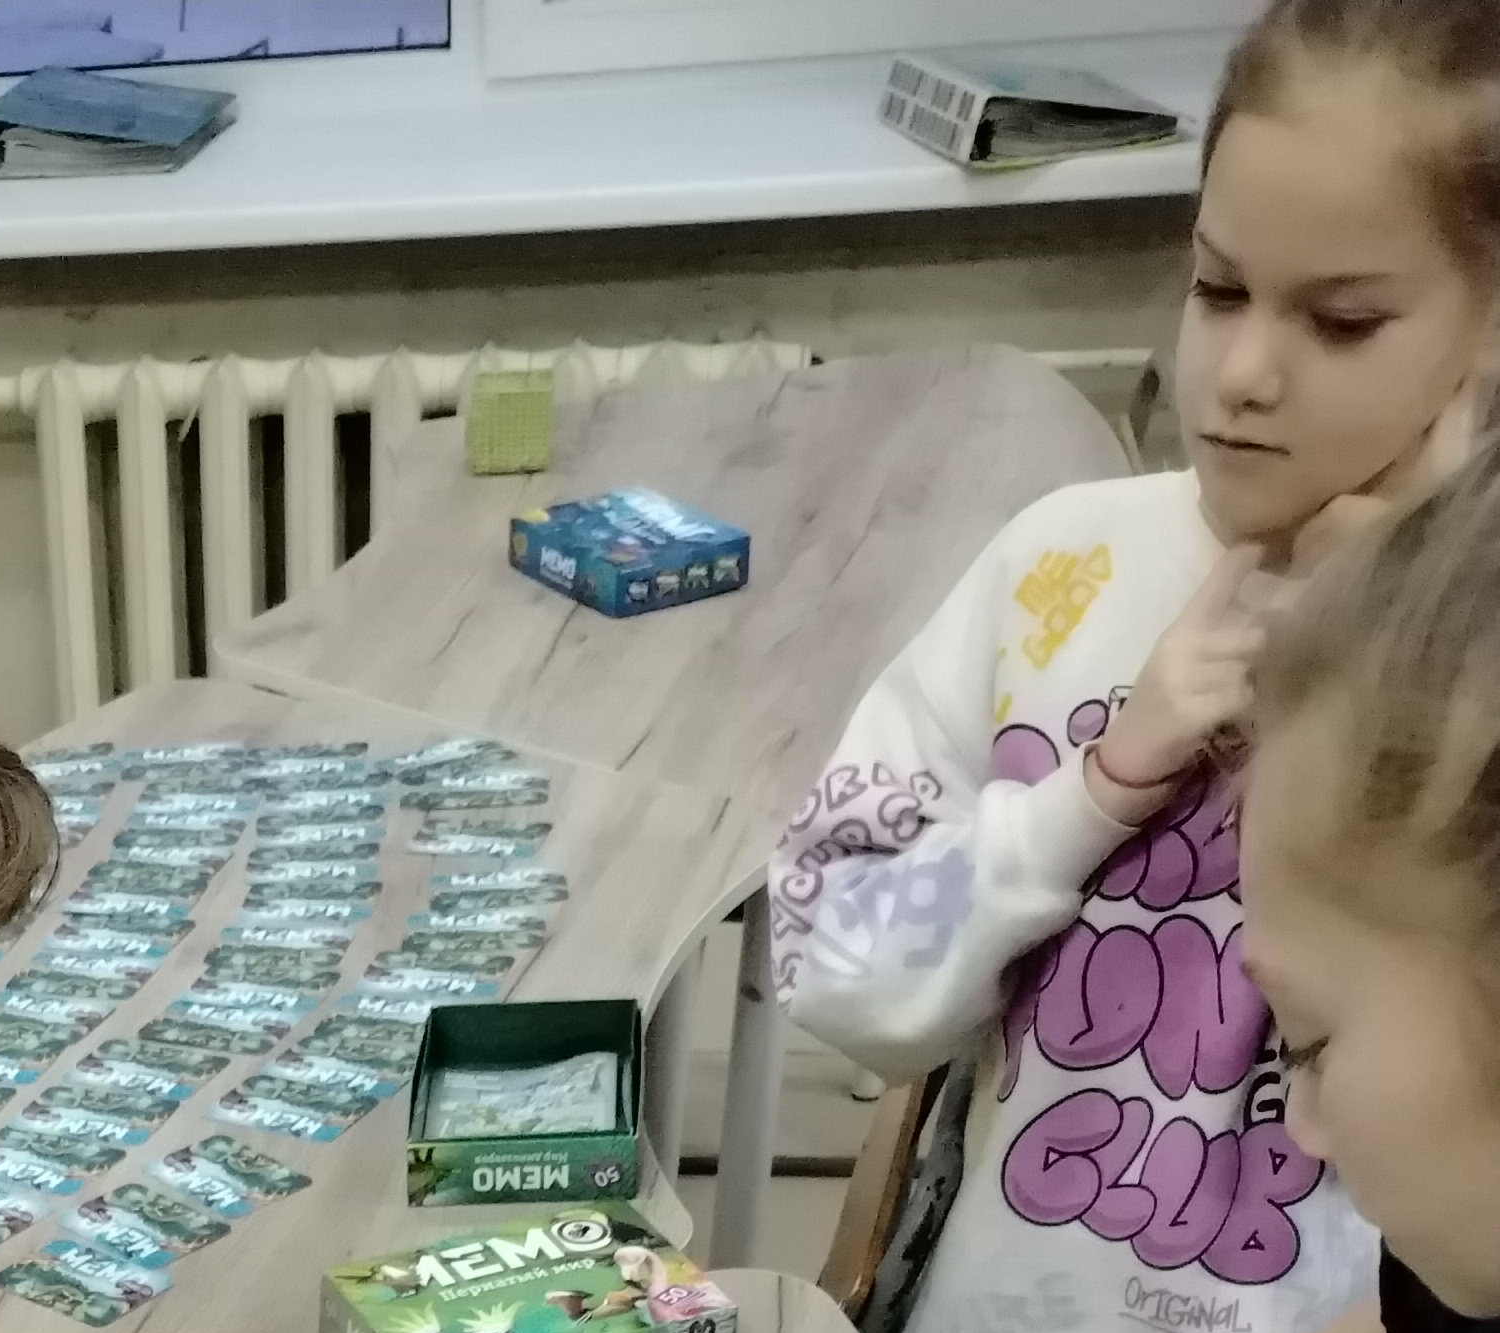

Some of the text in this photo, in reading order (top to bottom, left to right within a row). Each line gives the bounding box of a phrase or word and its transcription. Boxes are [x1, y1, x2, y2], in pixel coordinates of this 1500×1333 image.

[473, 1163, 570, 1193] МЕМО
[594, 1165, 621, 1188] 50
[438, 1266, 549, 1301] Пернатый
[660, 1288, 688, 1304] 50
